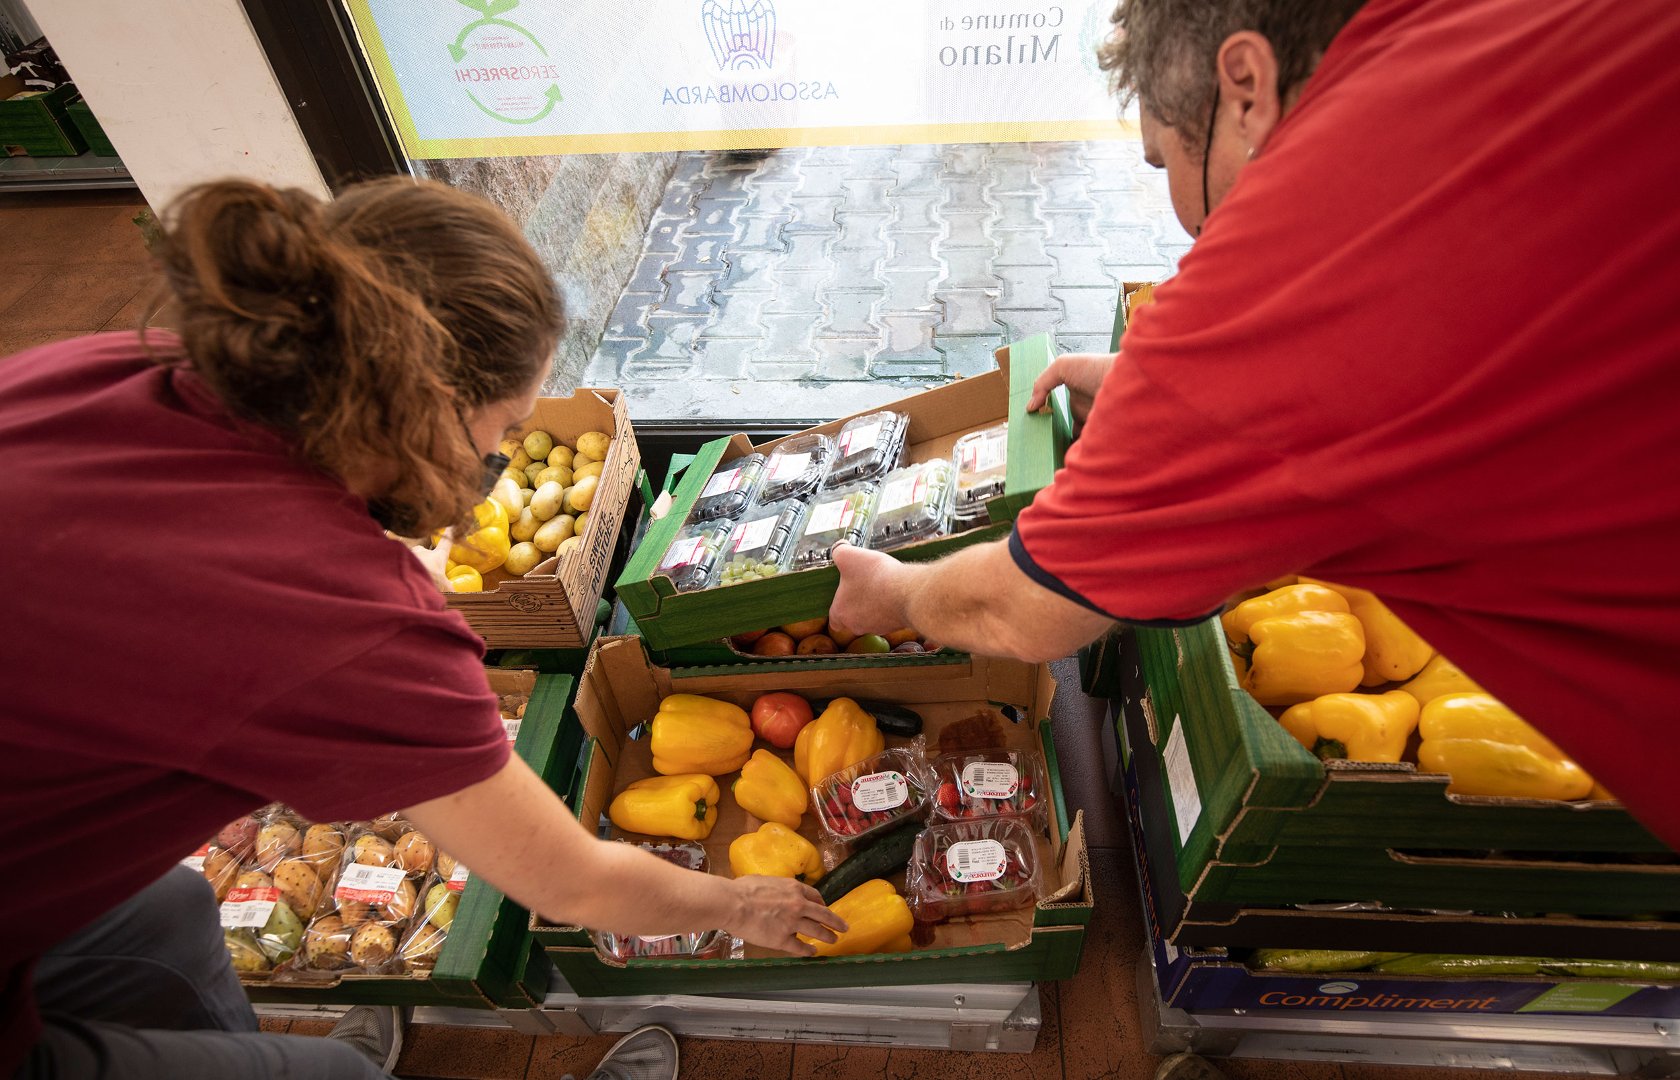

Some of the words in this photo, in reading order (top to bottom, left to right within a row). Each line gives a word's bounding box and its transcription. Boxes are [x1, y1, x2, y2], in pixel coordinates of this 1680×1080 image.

[589, 511, 606, 569] SWEET
[592, 512, 615, 594] POTATOES
[1259, 991, 1499, 1011] Compliment
